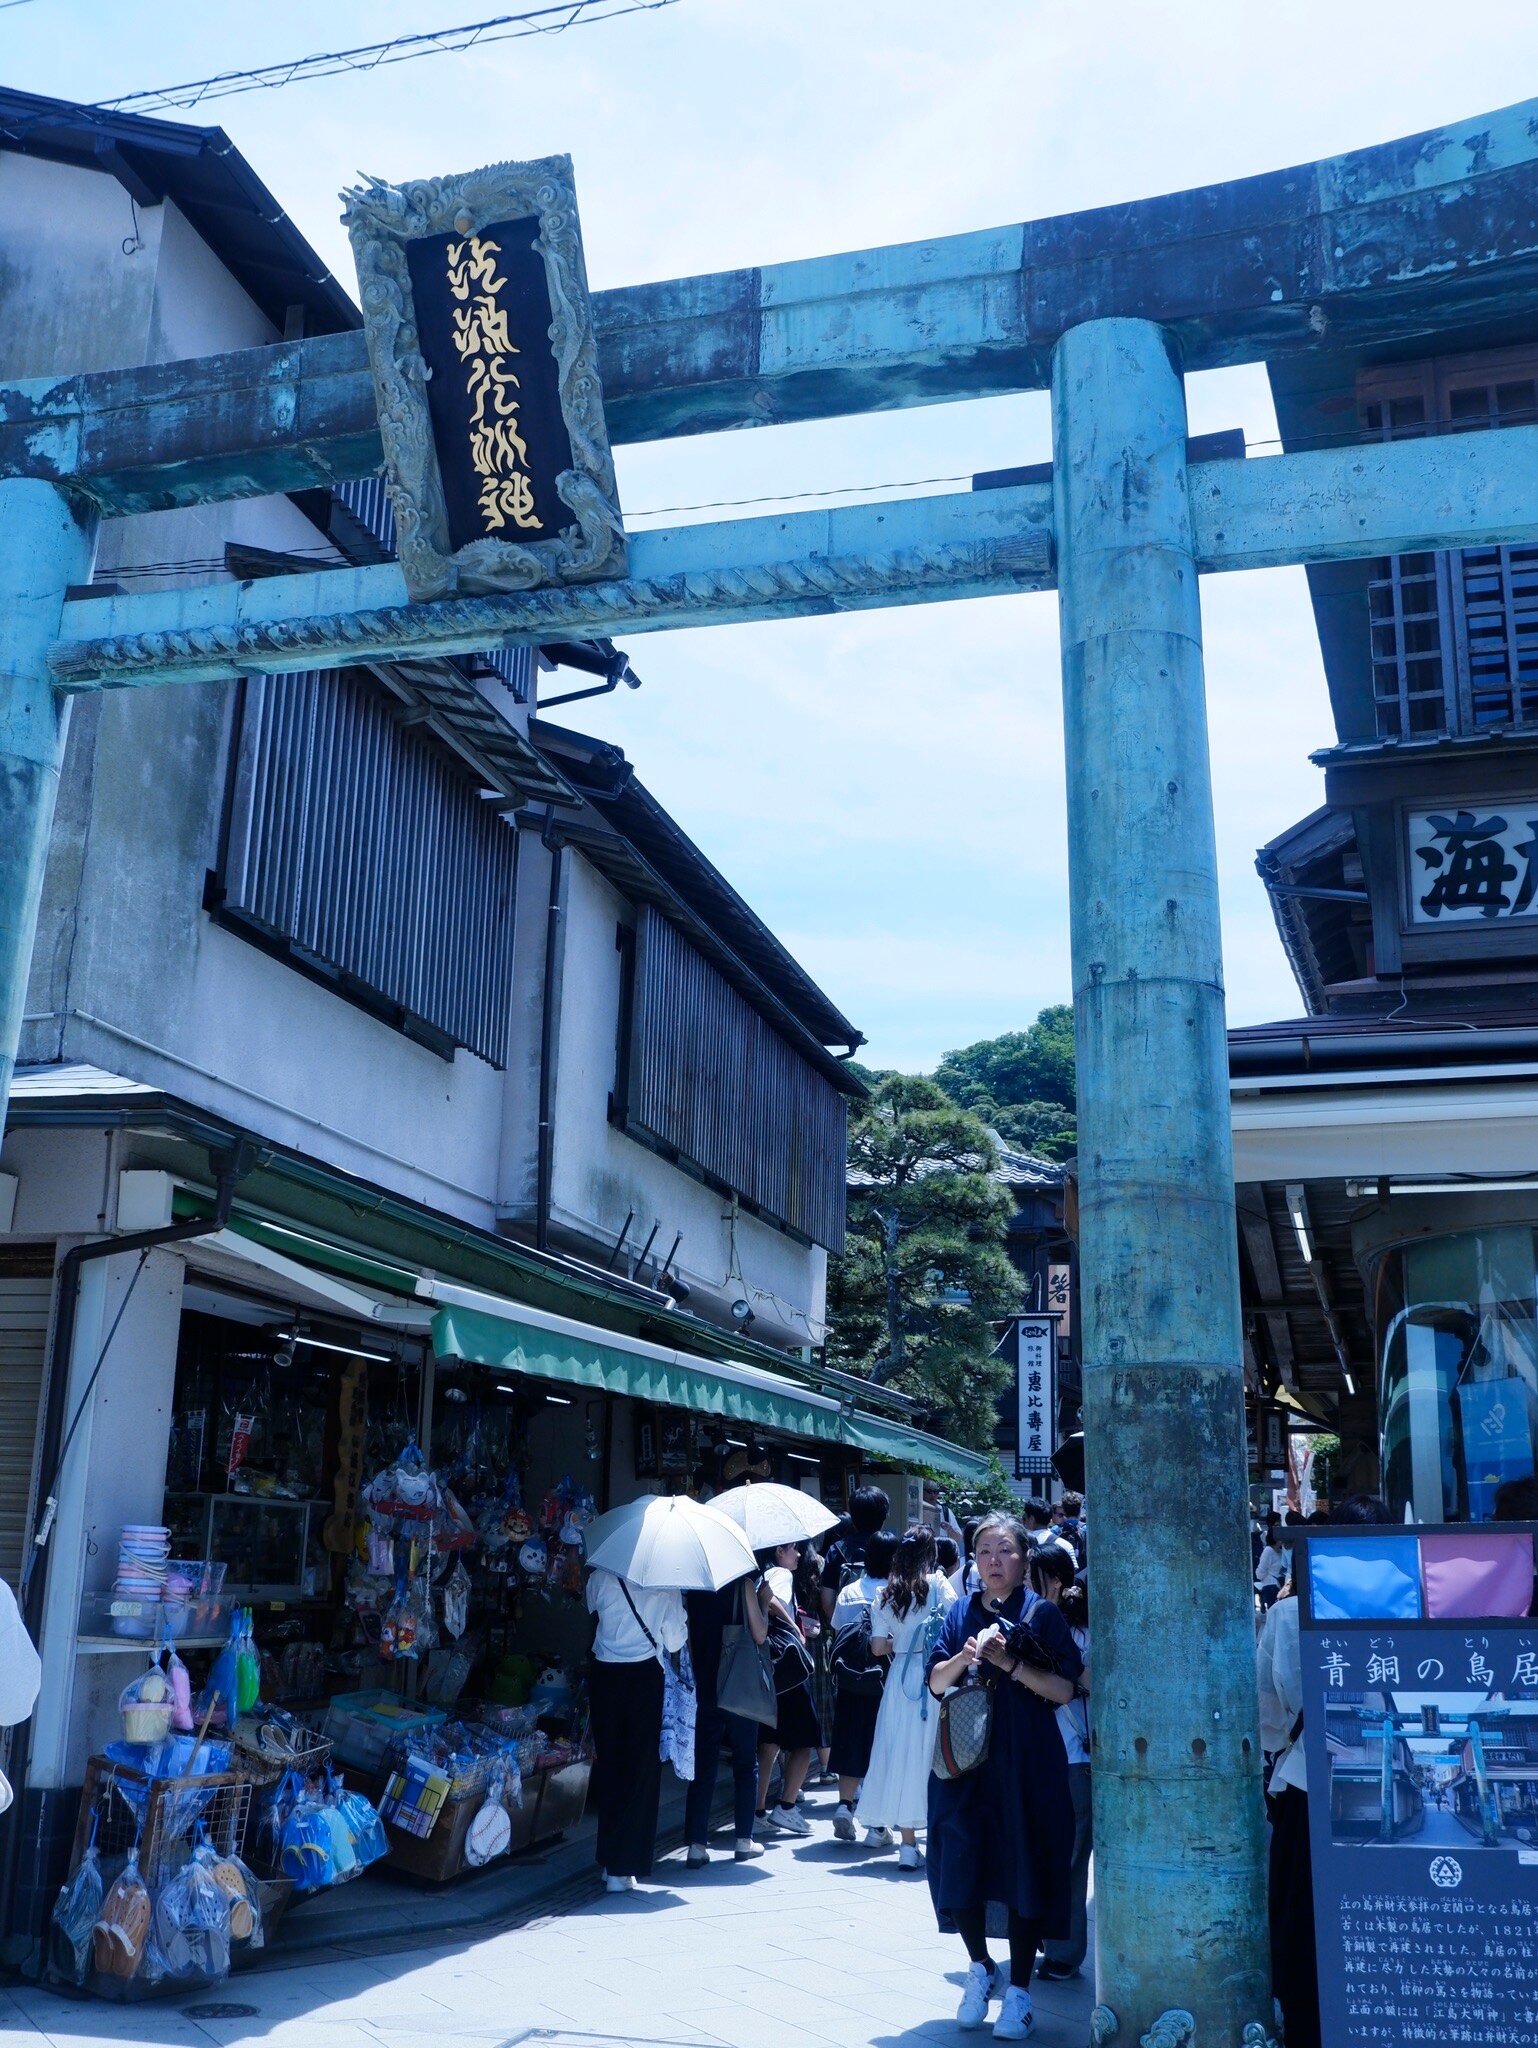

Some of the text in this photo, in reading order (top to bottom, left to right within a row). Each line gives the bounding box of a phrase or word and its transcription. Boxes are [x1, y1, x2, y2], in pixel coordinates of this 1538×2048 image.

[1415, 809, 1538, 918] 海
[1320, 1636, 1532, 1649] せい どう とり い
[1319, 1651, 1538, 1687] 青銅の鳥居
[1343, 1940, 1538, 1957] 青銅製で再建されました。鳥居の柱
